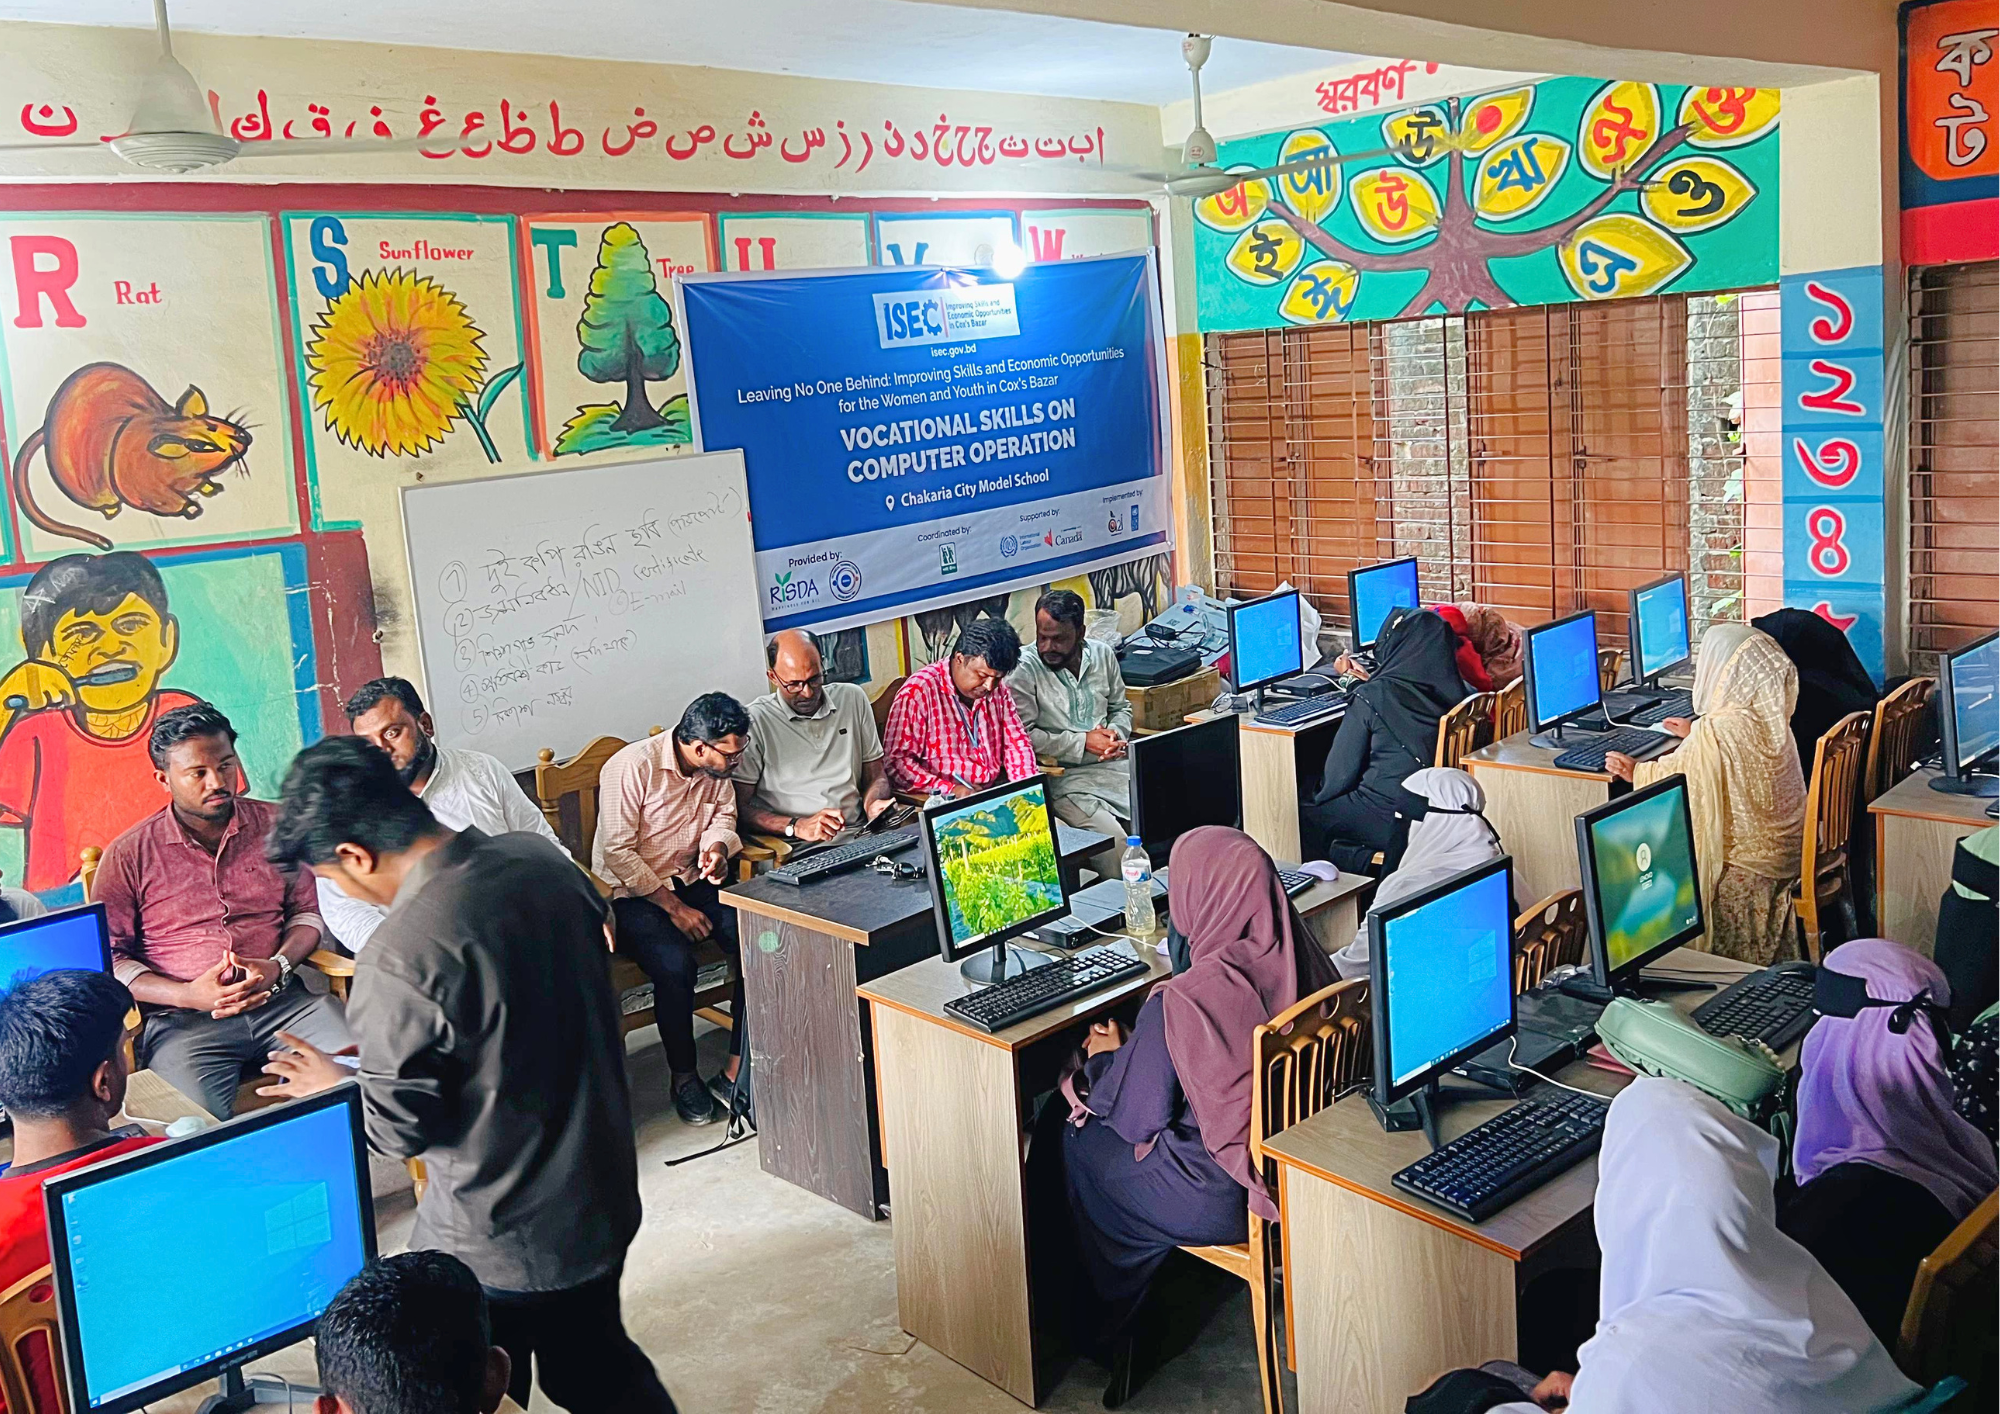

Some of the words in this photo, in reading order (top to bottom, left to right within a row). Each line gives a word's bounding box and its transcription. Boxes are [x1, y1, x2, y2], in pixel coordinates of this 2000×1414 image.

[1935, 28, 1999, 87] ক
[1933, 92, 1990, 167] ট
[1375, 170, 1408, 230] উ
[1668, 169, 1725, 217] ও
[310, 216, 350, 298] S
[379, 240, 475, 261] Sunflower
[531, 228, 578, 299] T
[10, 235, 87, 329] R
[115, 280, 162, 305] Rat
[883, 299, 942, 340] ISEC
[947, 311, 974, 319] Economic
[975, 308, 1011, 318] Opportunities
[955, 320, 970, 329] Cox's
[971, 319, 987, 328] Bazar
[1808, 283, 1852, 342] ১
[931, 343, 977, 358] isec.gov.bd
[737, 386, 792, 404] Leaving
[794, 382, 814, 397] No
[816, 380, 843, 395] One
[845, 373, 892, 391] Behind:
[894, 367, 952, 387] Improving
[953, 364, 983, 379] Skills
[985, 361, 1006, 374] and
[1007, 354, 1059, 372] Economic
[1060, 347, 1125, 368] Opportunities
[838, 398, 855, 413] for
[858, 396, 879, 411] the
[880, 391, 928, 407] Women
[930, 386, 951, 401] and
[952, 381, 985, 399] Youth
[986, 380, 998, 394] in
[999, 377, 1028, 392] Cox's
[1029, 374, 1058, 389] Bazar
[1801, 361, 1864, 413] ২
[840, 412, 977, 451] VOCATIONAL
[979, 402, 1045, 432] SKILLS
[1047, 397, 1076, 419] ON
[847, 444, 966, 483] COMPUTER
[969, 427, 1076, 464] OPERATION
[1797, 441, 1859, 487] ৩
[901, 486, 952, 507] Chakaria
[954, 482, 976, 499] City
[979, 475, 1012, 494] Model
[1014, 468, 1050, 487] School
[1102, 490, 1136, 504] Implemented
[917, 526, 960, 542] Coordinated
[1019, 509, 1051, 523] Supported
[788, 551, 827, 568] Provided
[829, 551, 843, 562] by:
[1055, 532, 1083, 547] Canada
